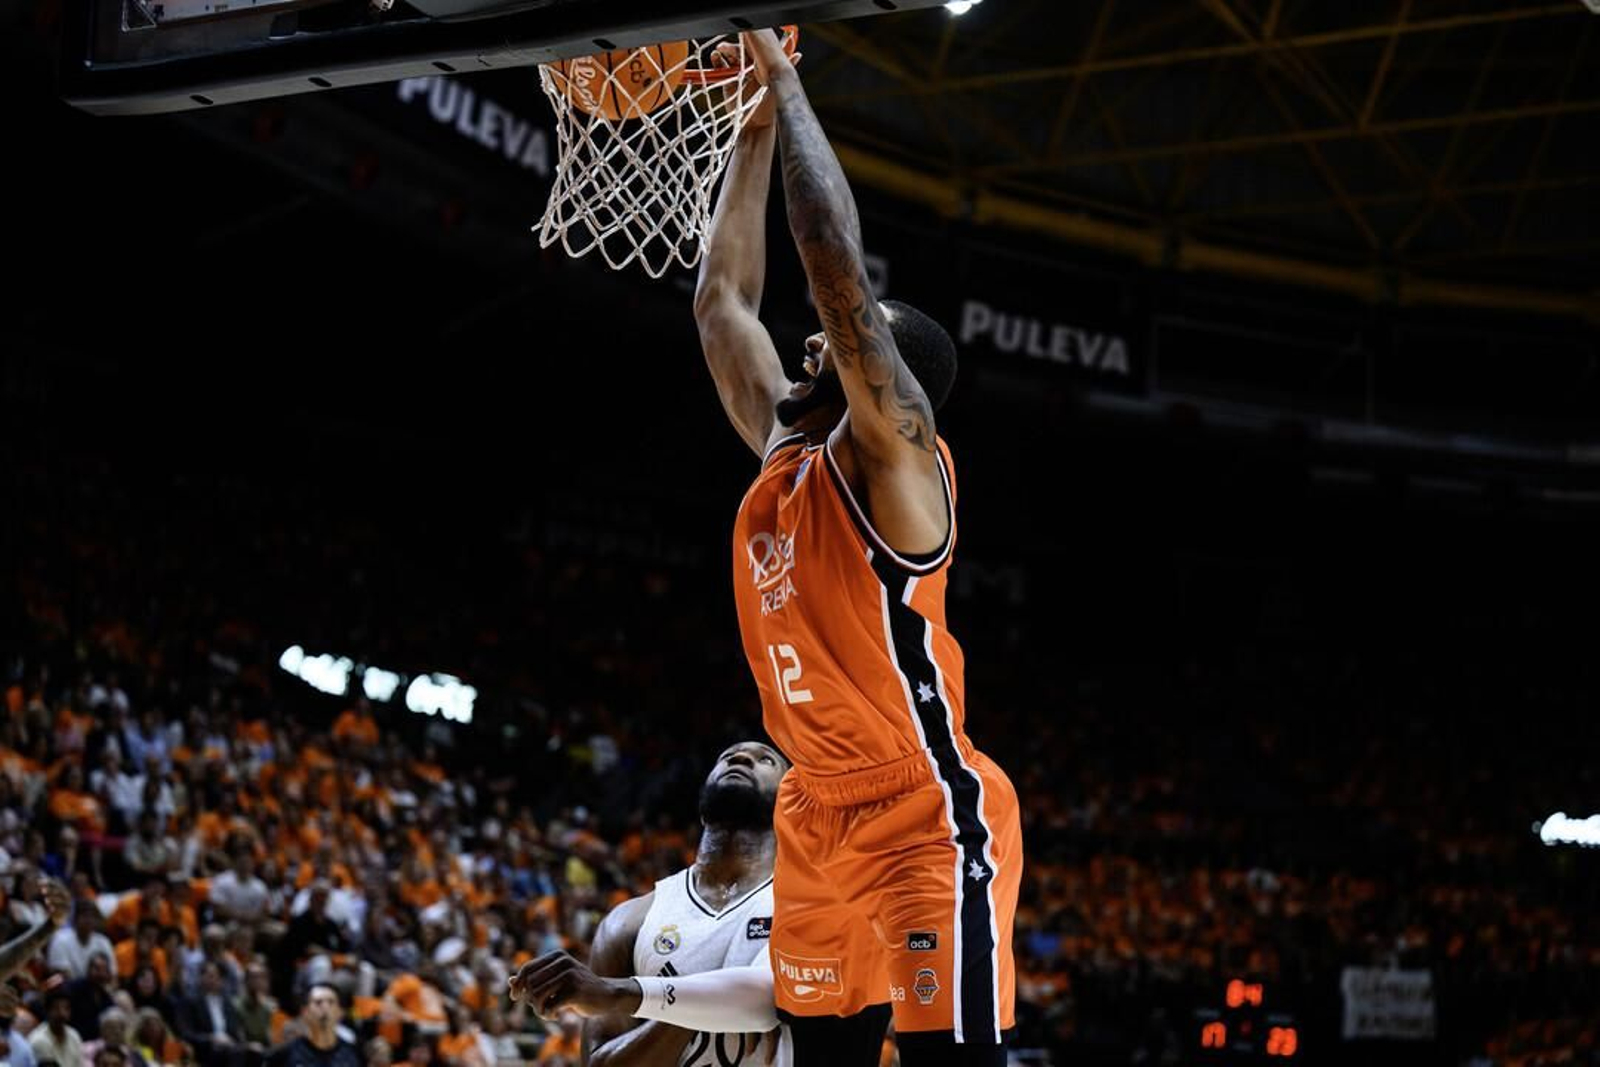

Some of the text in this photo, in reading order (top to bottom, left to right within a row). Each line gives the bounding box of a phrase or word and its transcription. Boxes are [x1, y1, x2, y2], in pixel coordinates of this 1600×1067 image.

[959, 300, 1131, 376] PULEVA
[768, 644, 814, 705] 12
[910, 940, 931, 949] acb
[779, 959, 837, 983] PULEVA
